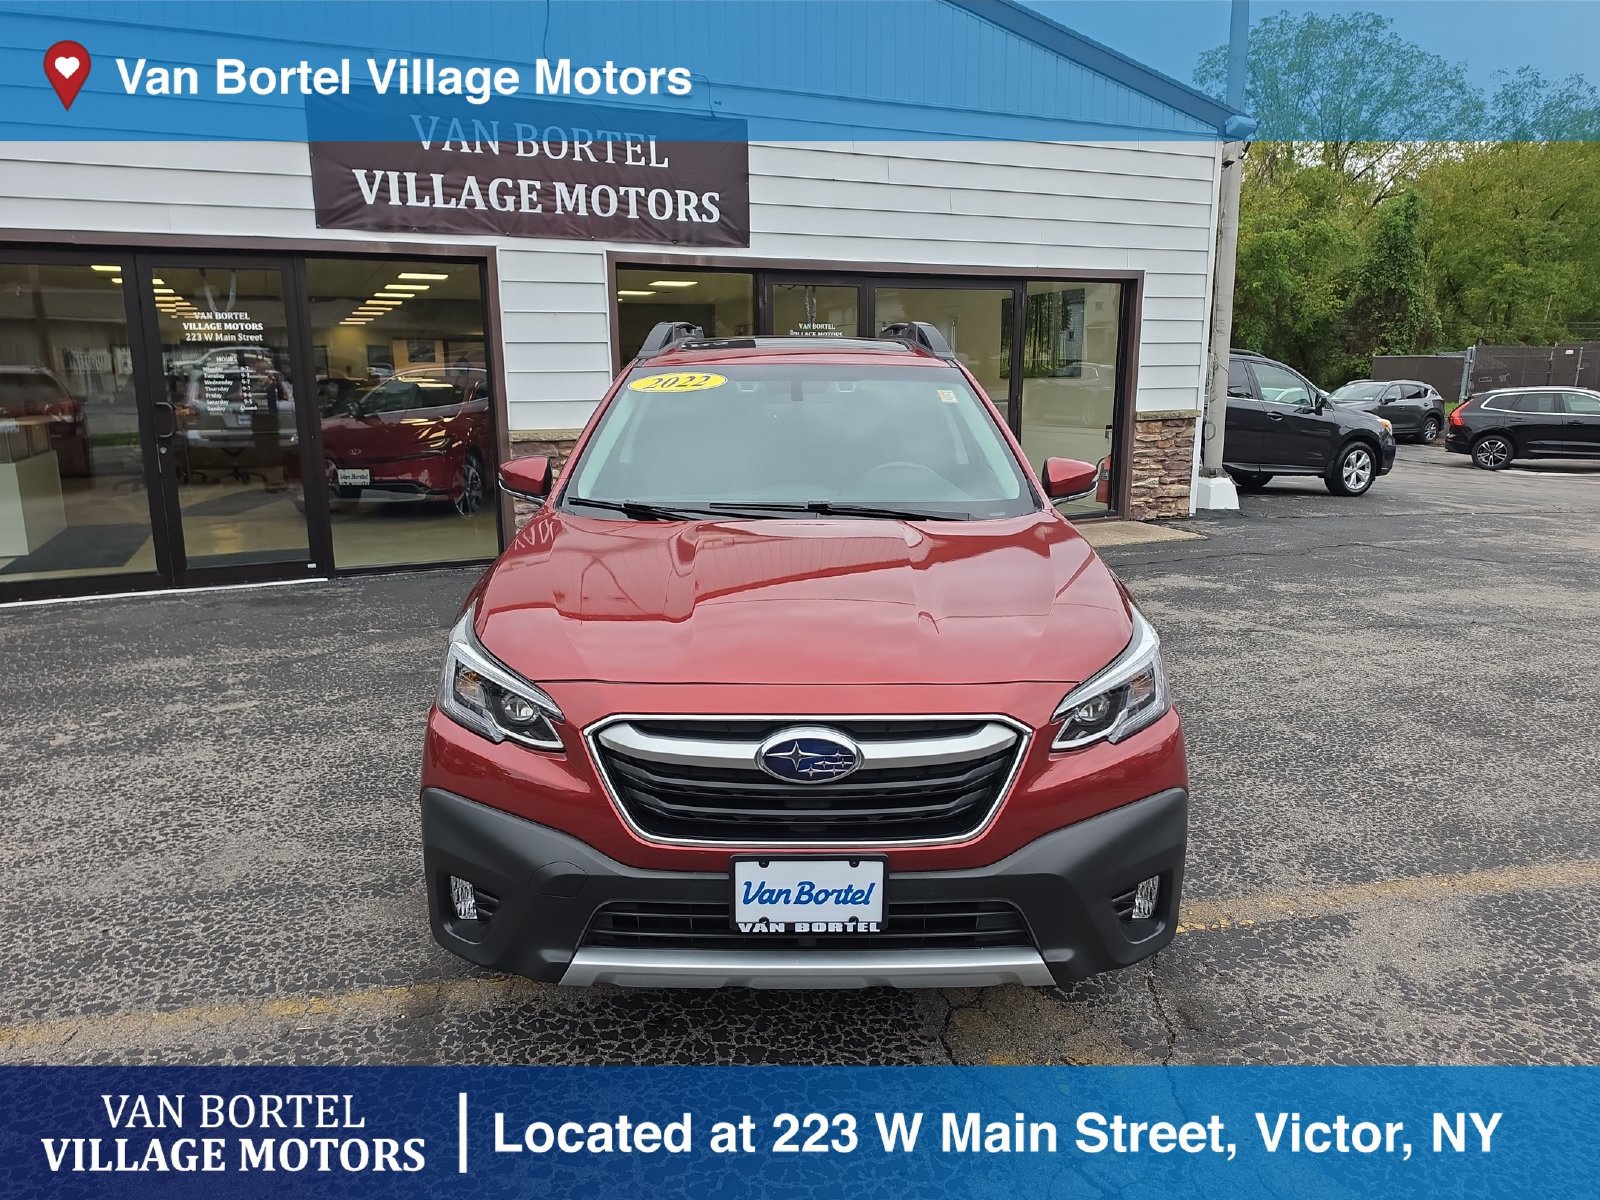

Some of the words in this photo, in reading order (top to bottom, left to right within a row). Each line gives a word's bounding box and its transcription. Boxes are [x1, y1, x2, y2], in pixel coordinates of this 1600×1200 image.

[410, 114, 499, 156] VAN
[515, 122, 670, 168] BORTEL
[352, 169, 542, 214] VILLAGE
[555, 182, 721, 223] MOTORS
[194, 312, 213, 320] VAN
[214, 312, 251, 320] BORTEL
[182, 322, 222, 331] VILLAGE
[224, 322, 264, 331] MOTORS
[185, 333, 202, 342] 223
[204, 333, 213, 341] W
[215, 333, 236, 342] Main
[237, 333, 264, 342] Street
[642, 375, 711, 389] 2022
[742, 880, 792, 905] Van
[793, 880, 876, 906] Bortel
[738, 922, 786, 933] VAN
[794, 921, 881, 933] BORTEL
